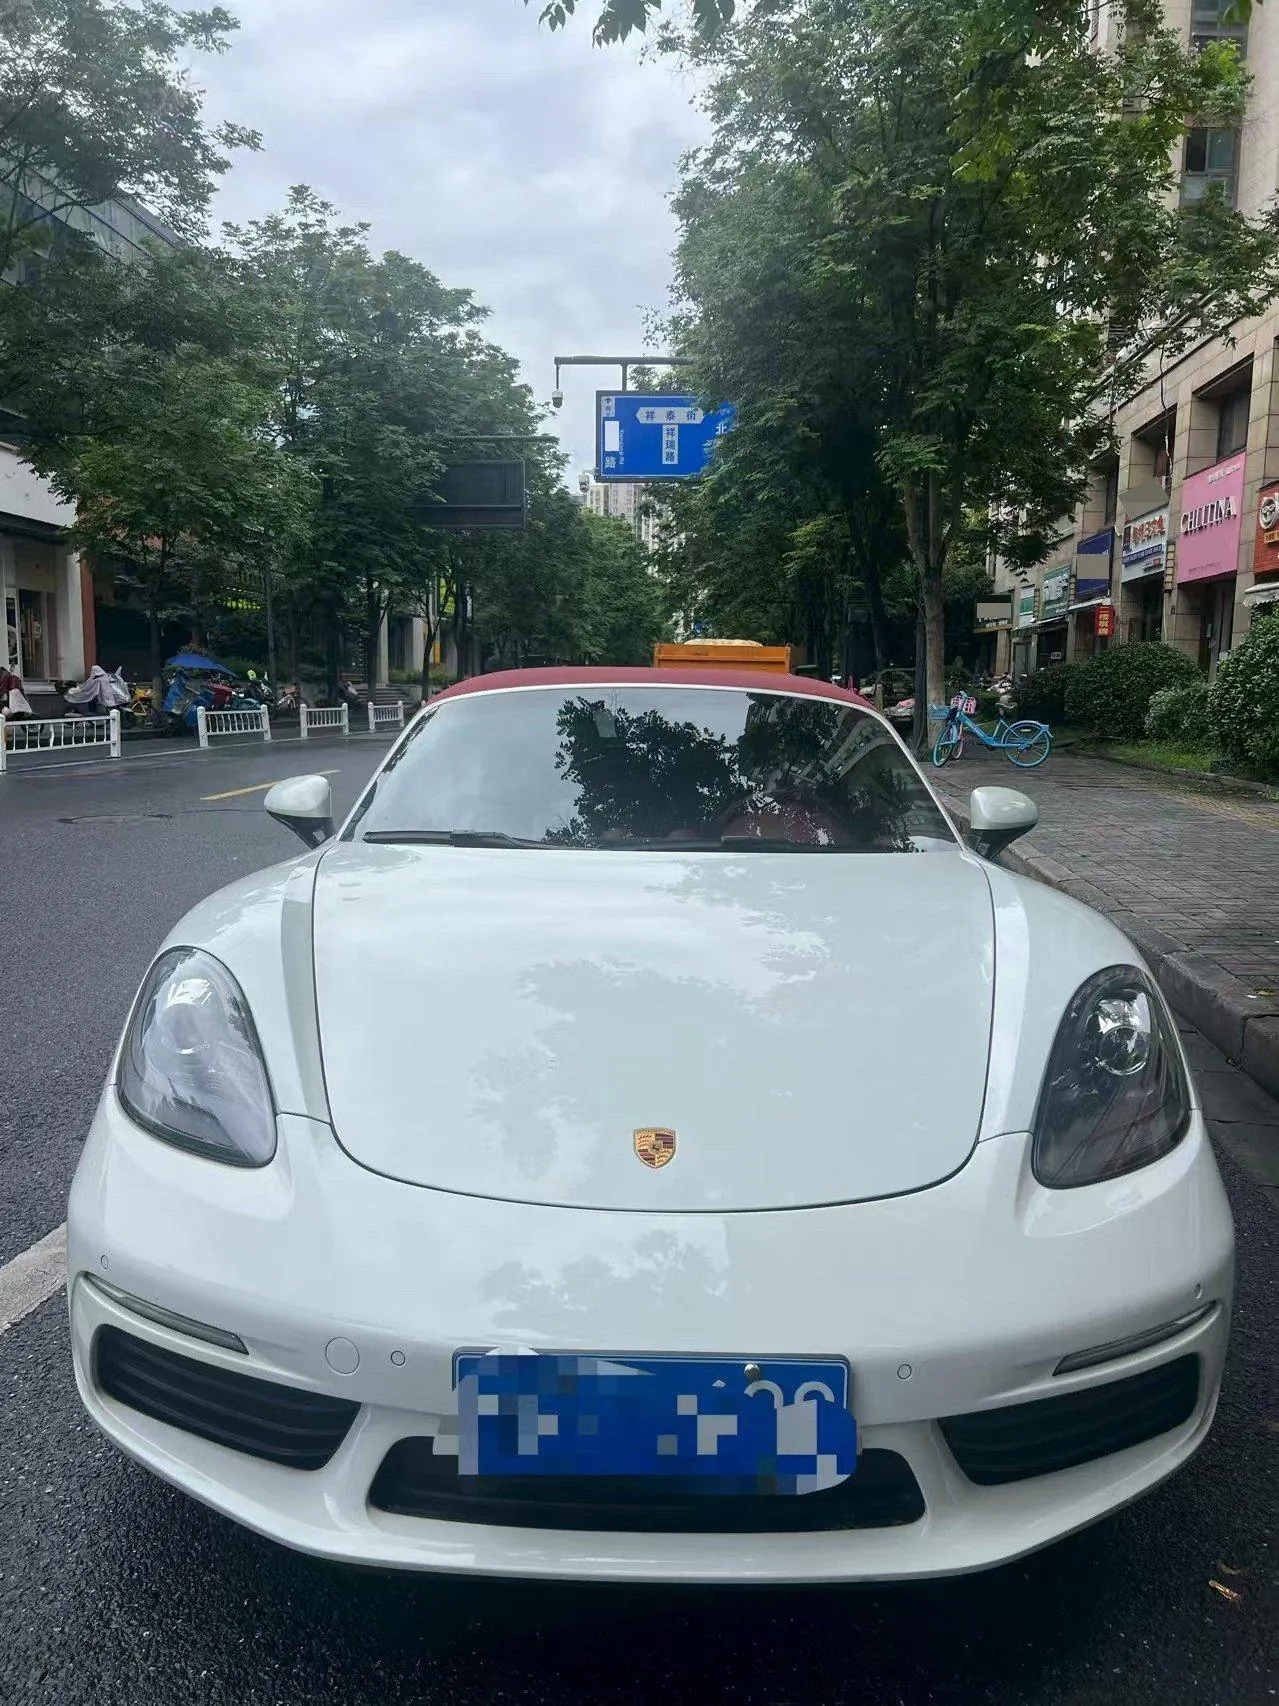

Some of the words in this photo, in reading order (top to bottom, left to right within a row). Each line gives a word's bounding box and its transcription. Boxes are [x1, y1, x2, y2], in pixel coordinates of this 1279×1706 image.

[645, 410, 696, 421] 祥泰街
[715, 424, 728, 435] 北
[665, 427, 676, 462] 祥瑞路
